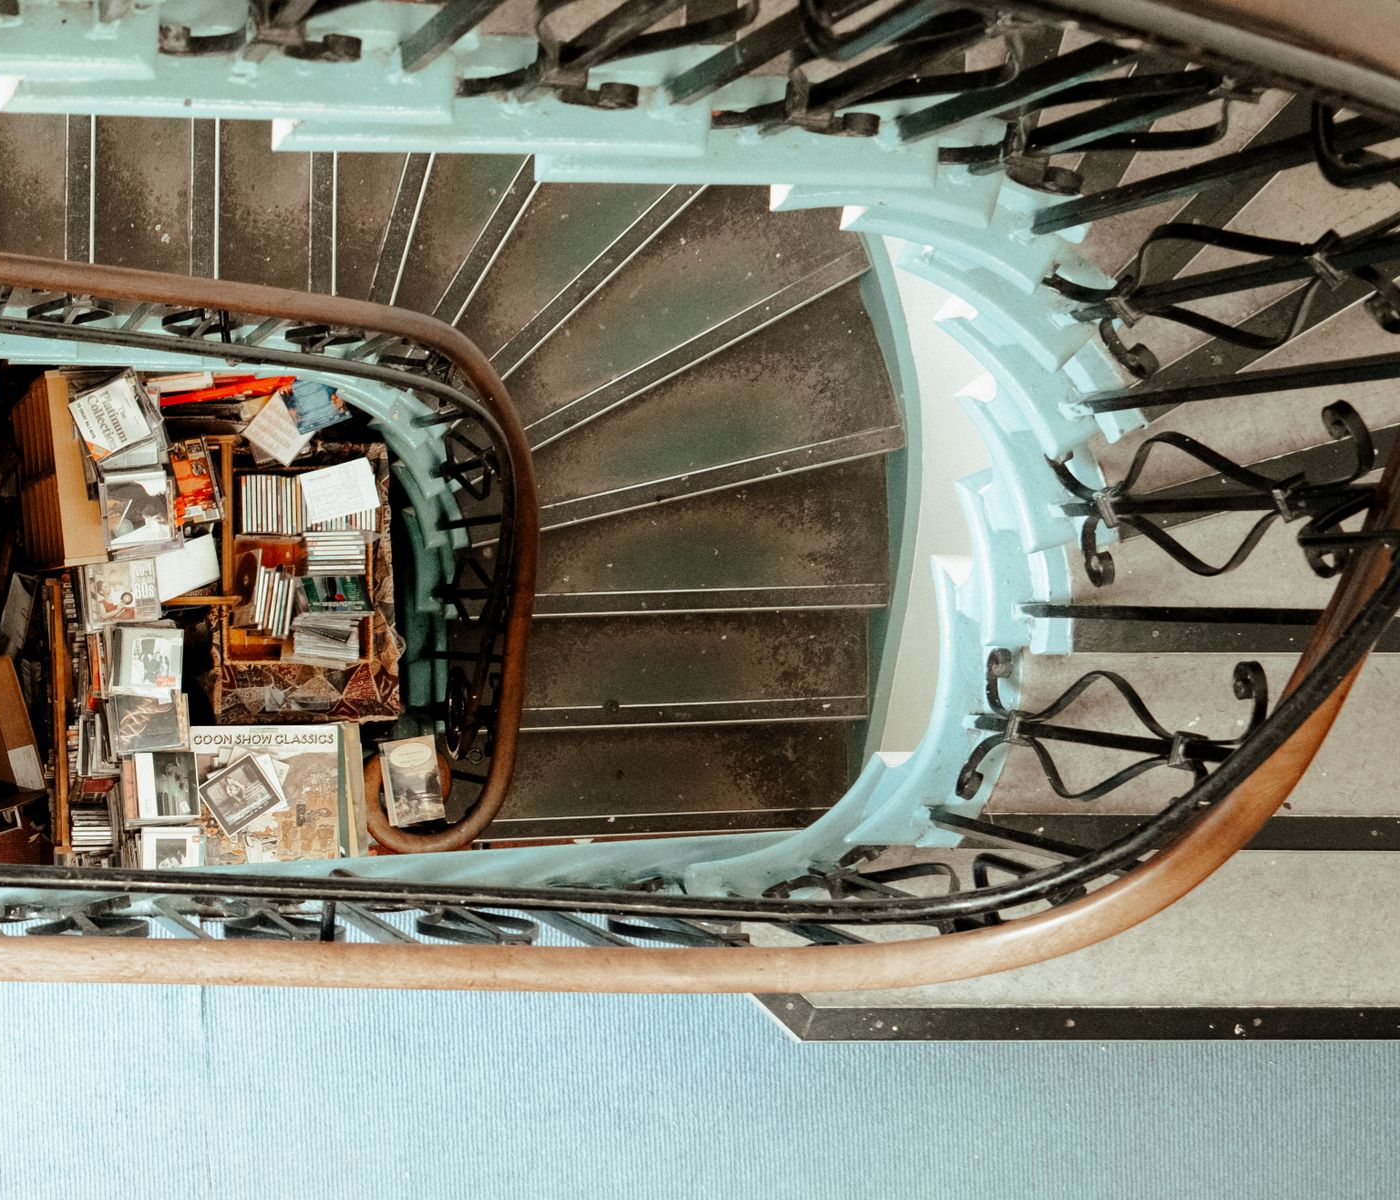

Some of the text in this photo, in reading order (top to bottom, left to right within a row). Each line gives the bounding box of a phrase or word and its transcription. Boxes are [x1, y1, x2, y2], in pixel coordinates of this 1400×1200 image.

[98, 390, 128, 443] Platinum
[118, 405, 127, 420] The
[87, 393, 118, 451] Collection
[134, 581, 155, 599] 80s
[193, 733, 335, 745] GOON SHOW CLASSICS
